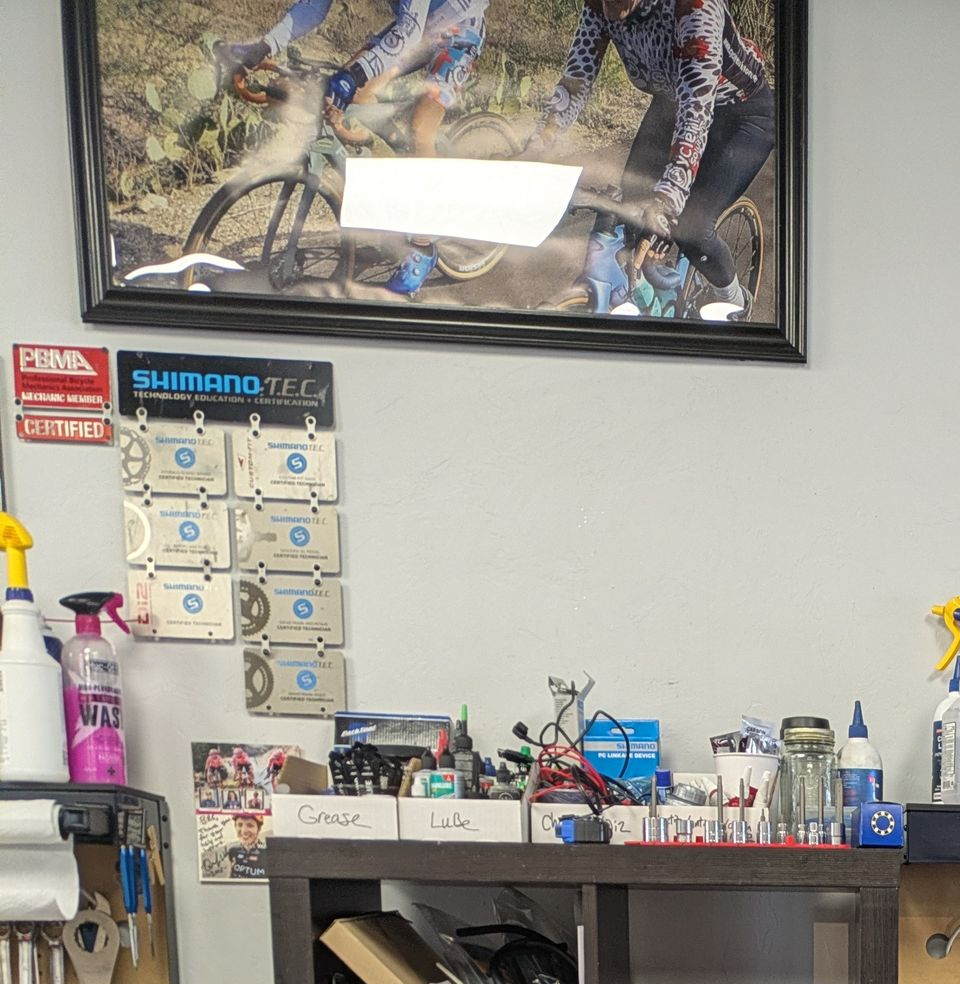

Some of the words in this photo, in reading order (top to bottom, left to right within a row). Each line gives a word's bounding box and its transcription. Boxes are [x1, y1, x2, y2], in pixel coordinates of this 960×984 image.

[19, 346, 94, 371] PBMA
[131, 369, 261, 395] SHIMANO
[21, 391, 65, 402] MECHANIC
[66, 393, 103, 403] MEMBER
[132, 390, 193, 401] TECHNOLOGY
[194, 393, 245, 404] EDUCATION
[254, 395, 319, 407] CERTIFICATION
[24, 418, 105, 438] CERTIFIED
[79, 703, 123, 730] WAS
[297, 803, 372, 829] Grease
[233, 863, 266, 876] OPTUM
